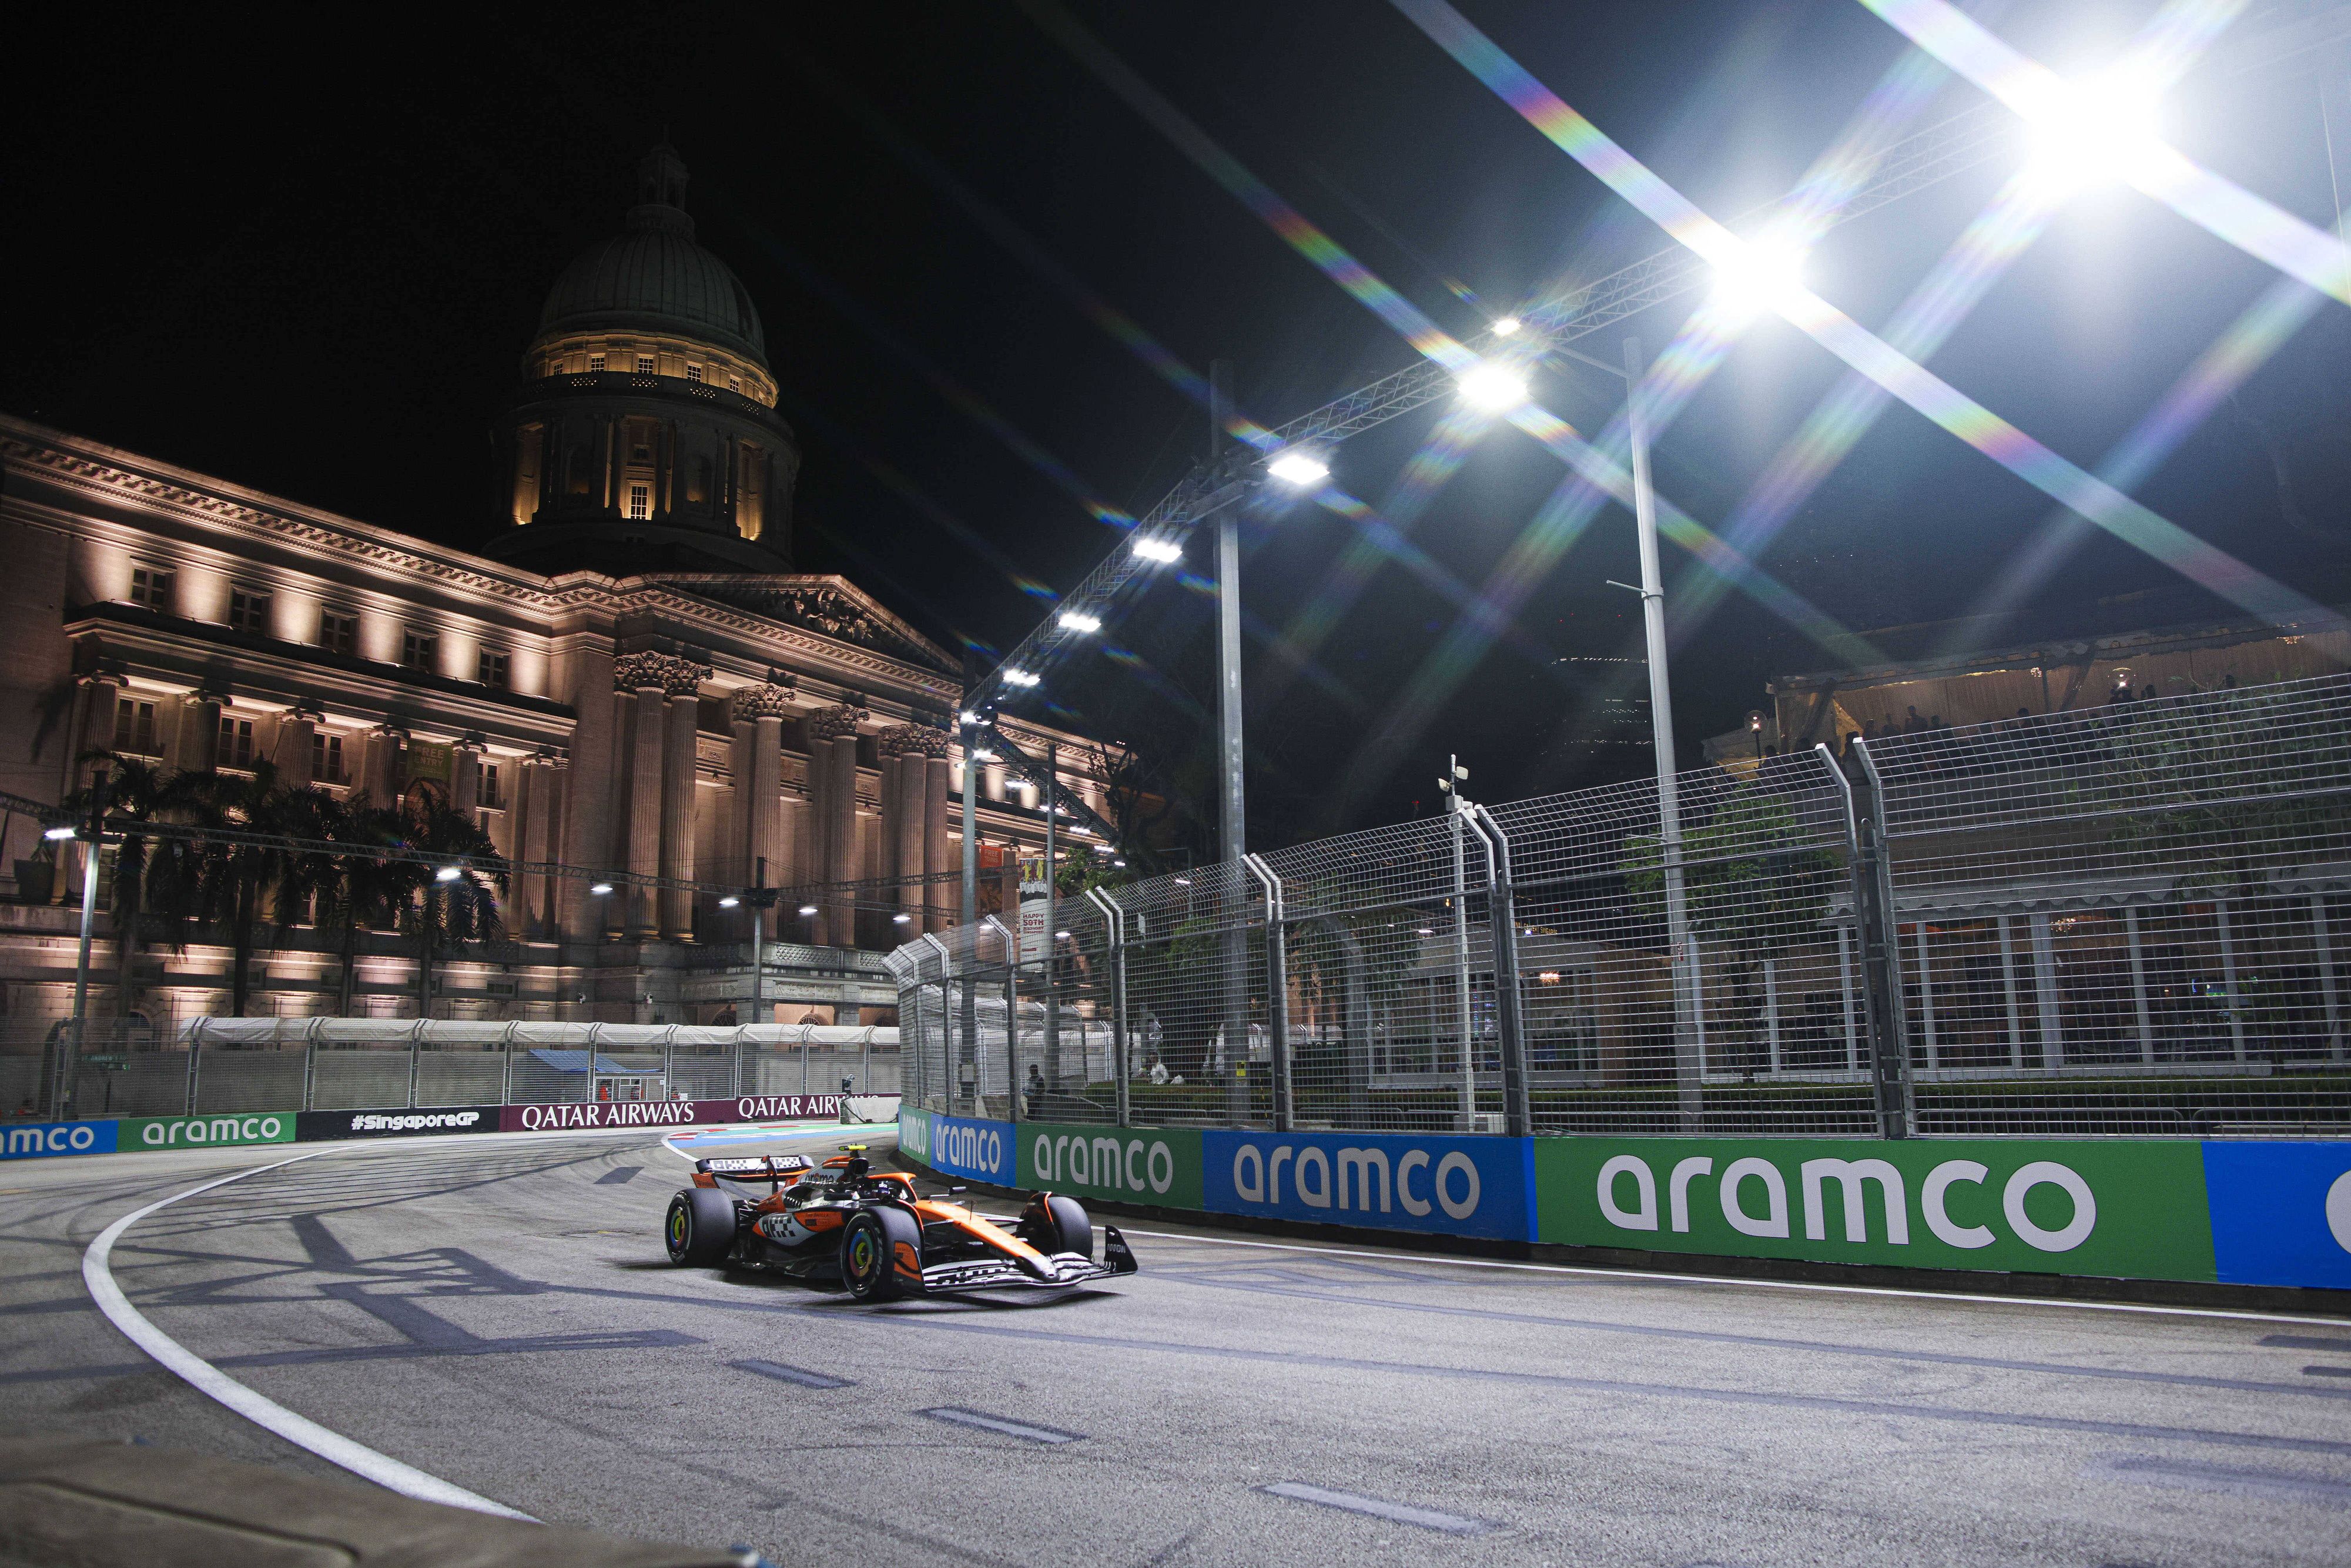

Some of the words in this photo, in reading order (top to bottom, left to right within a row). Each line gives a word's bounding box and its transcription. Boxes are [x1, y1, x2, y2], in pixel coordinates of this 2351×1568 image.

[351, 1112, 480, 1130] #SingaporeGP
[521, 1105, 600, 1130] QATAR
[605, 1102, 694, 1125] AIRWAYS
[738, 1097, 802, 1119] QATAR
[0, 1127, 94, 1153] mco
[143, 1117, 281, 1144] aramco
[902, 1113, 926, 1155] aramco
[936, 1124, 1000, 1174] aramco
[1034, 1134, 1173, 1194] aramco
[1234, 1144, 1480, 1219] aramco
[1597, 1154, 2097, 1252] aramco
